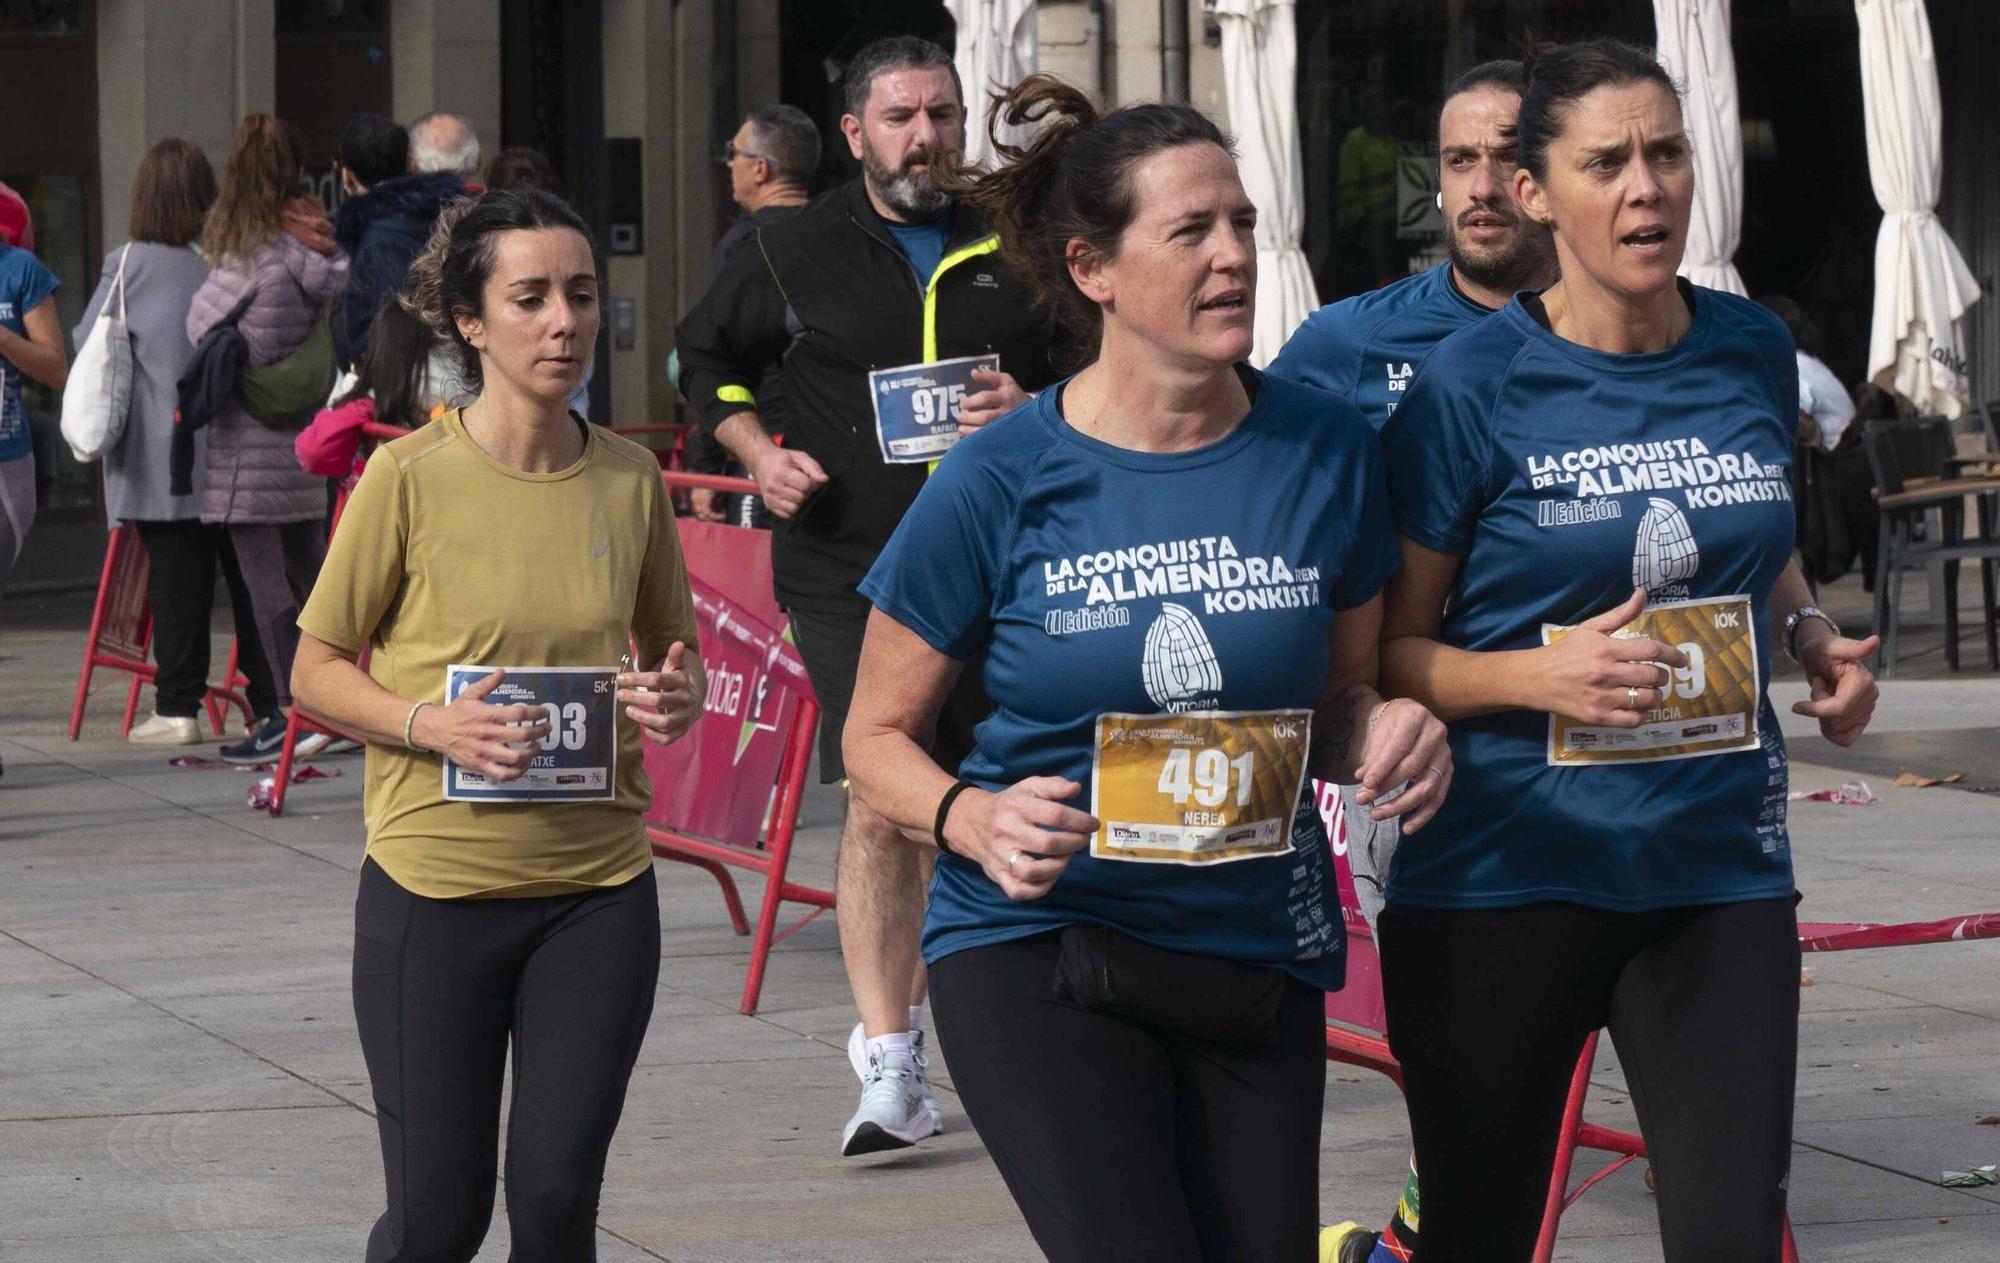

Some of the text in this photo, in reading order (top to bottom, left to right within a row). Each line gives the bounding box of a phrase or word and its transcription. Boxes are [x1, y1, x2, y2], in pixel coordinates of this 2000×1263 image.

[1386, 362, 1414, 379] LA
[1388, 380, 1406, 391] DE
[911, 384, 967, 425] 975
[1527, 437, 1709, 476] LA CONQUISTA
[1532, 474, 1555, 490] DE
[1555, 471, 1578, 484] LA
[1577, 452, 1765, 498] ALMENDRA
[1685, 481, 1792, 510] KONKISTA
[1538, 495, 1622, 527] II Edición
[1044, 536, 1238, 583] LA CONQUISTA
[1046, 555, 1320, 606] DE LA ALMENDRA REN
[1204, 583, 1320, 615] KONKISTA
[1045, 602, 1130, 636] II Edición
[1714, 611, 1739, 629] 10K
[594, 680, 608, 693] 5K
[1166, 698, 1219, 714] VITORIA
[1646, 707, 1683, 722] ETICIA
[1272, 722, 1298, 739] 10K
[530, 755, 555, 767] ATXE
[1158, 748, 1254, 807] 491
[1184, 811, 1226, 826] NEREA
